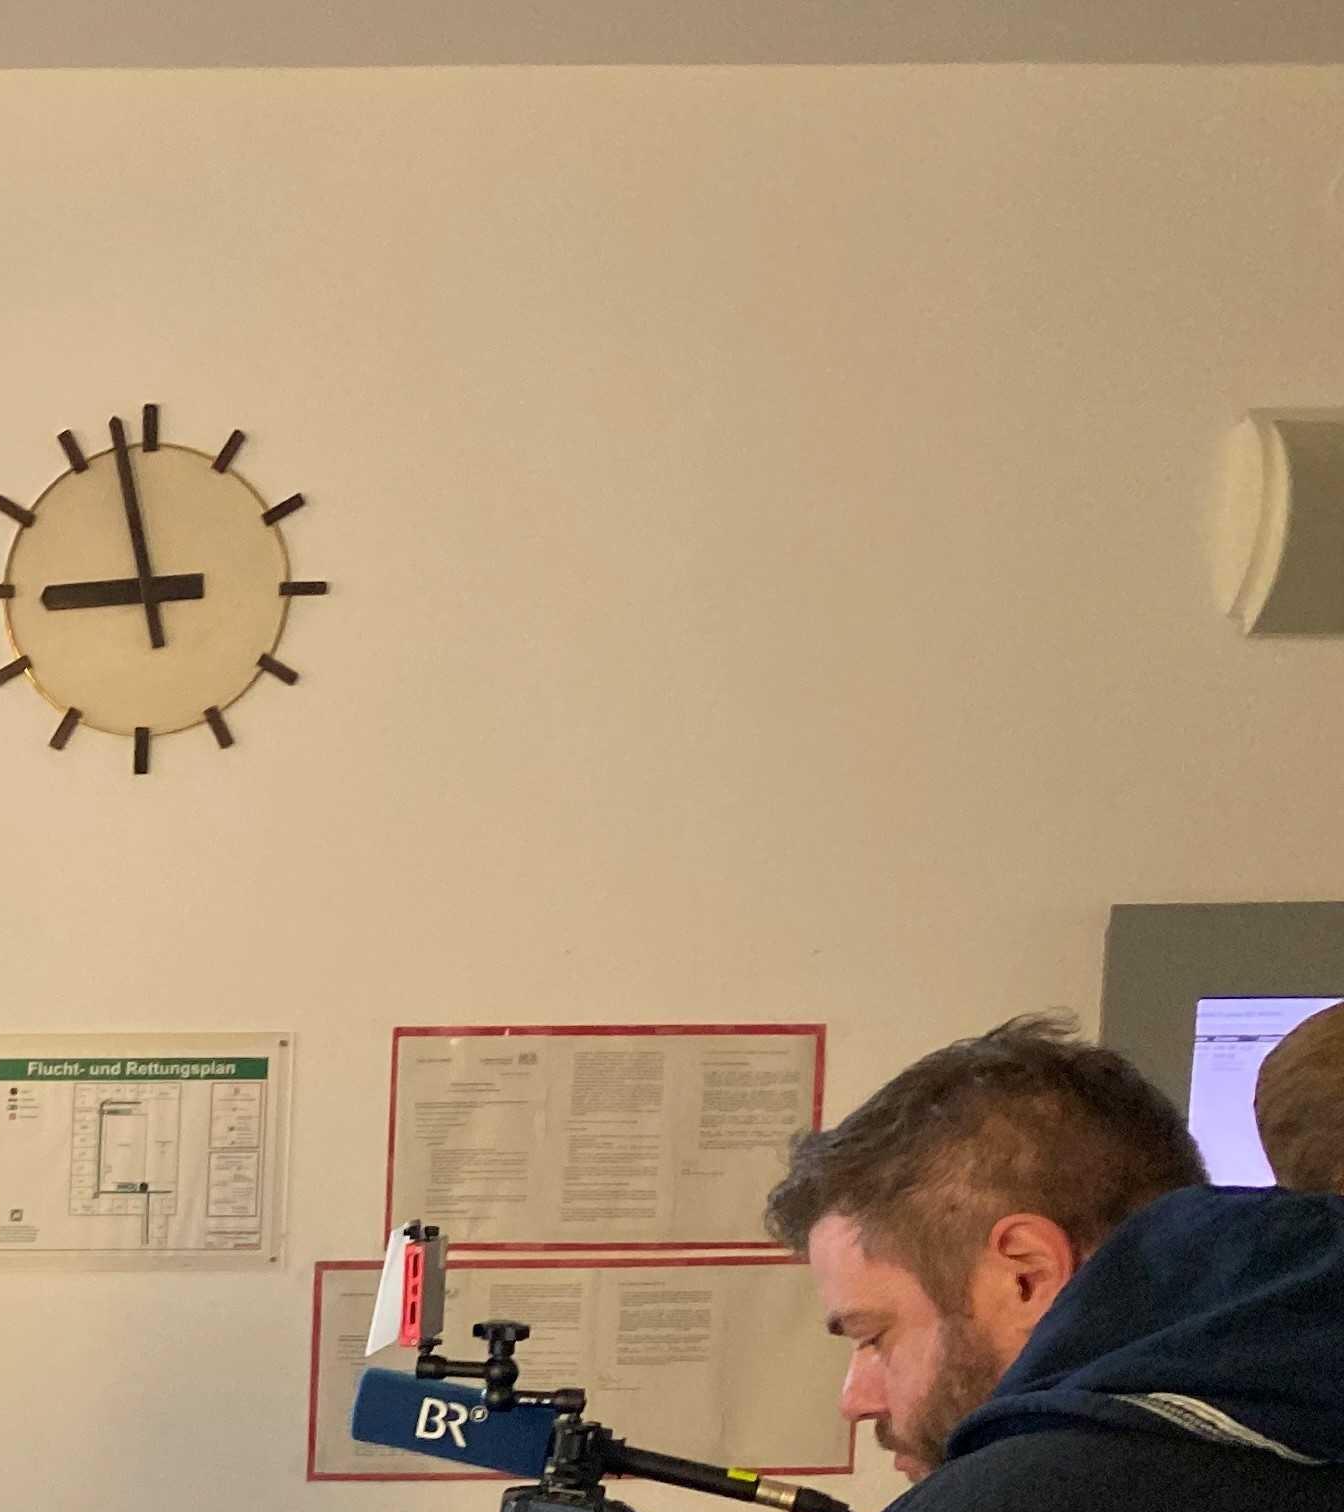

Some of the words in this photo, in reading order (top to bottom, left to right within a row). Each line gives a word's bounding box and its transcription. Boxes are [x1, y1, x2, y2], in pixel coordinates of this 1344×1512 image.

[27, 1061, 85, 1077] Flucht-
[89, 1061, 120, 1076] und
[125, 1060, 236, 1078] Rettungsplan
[415, 1397, 468, 1448] BR
